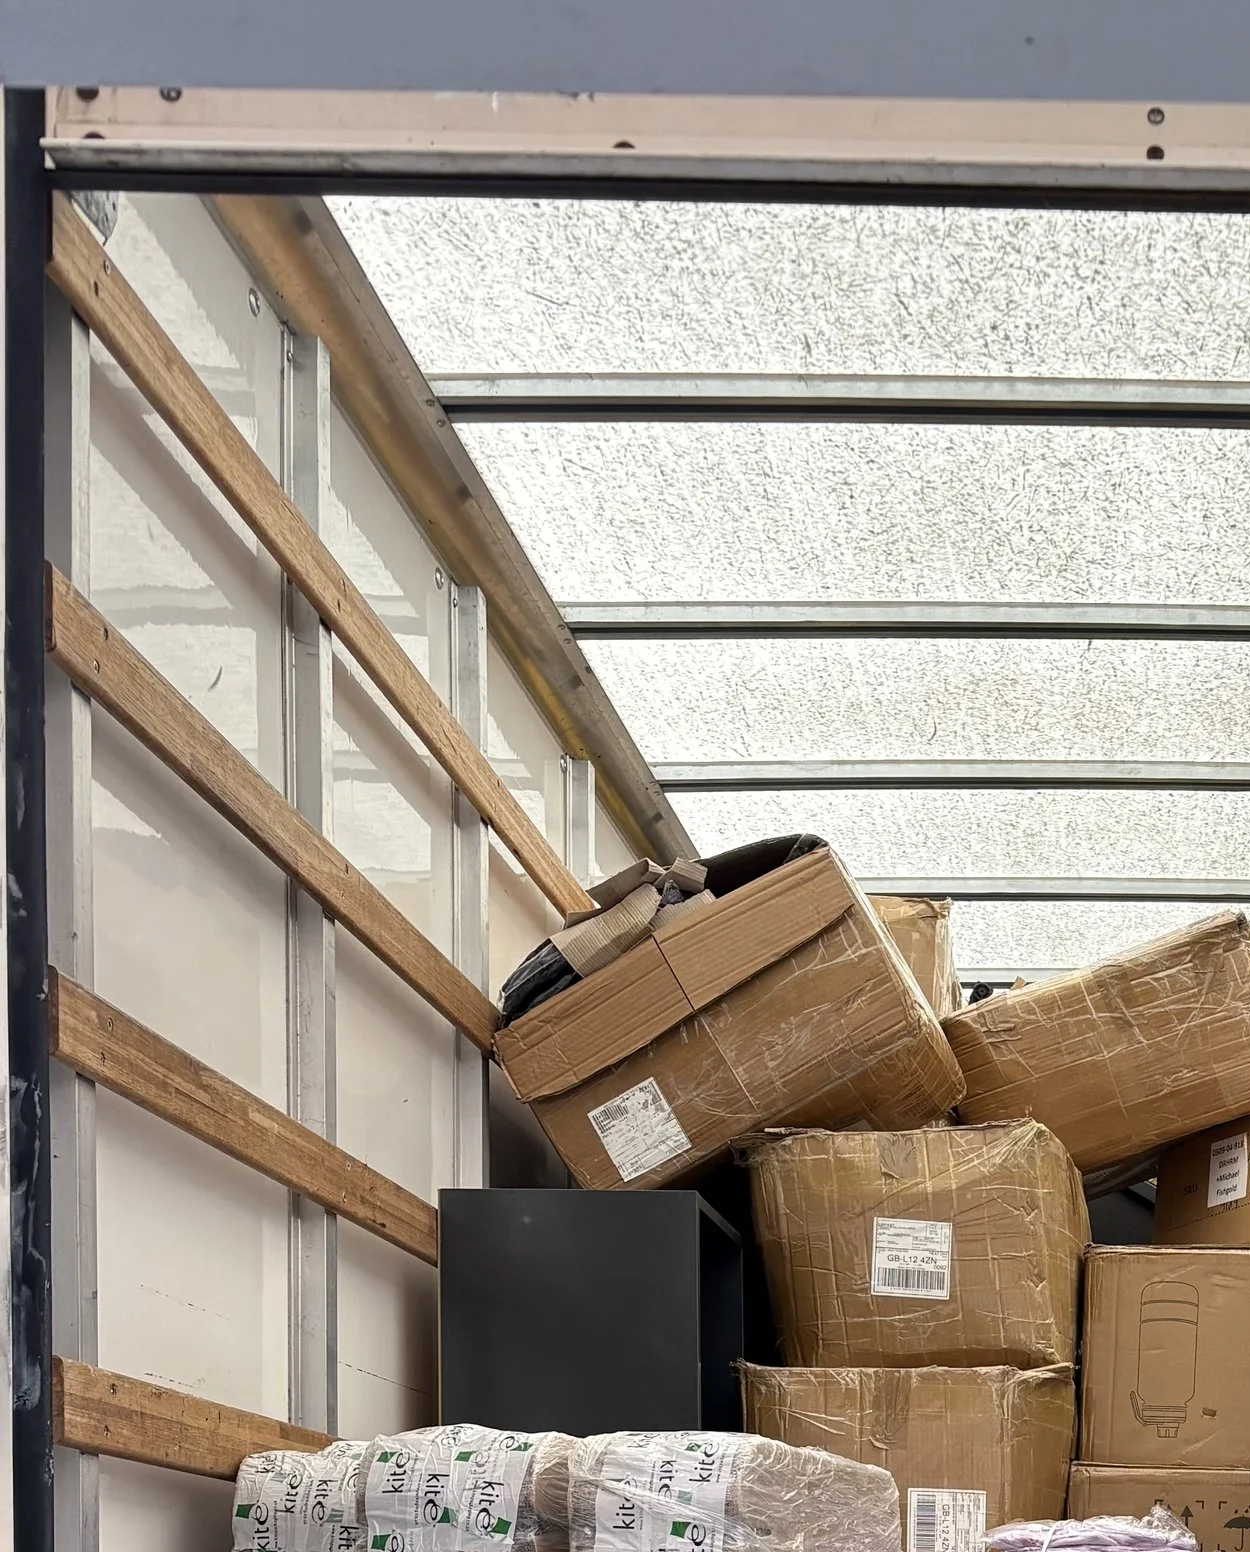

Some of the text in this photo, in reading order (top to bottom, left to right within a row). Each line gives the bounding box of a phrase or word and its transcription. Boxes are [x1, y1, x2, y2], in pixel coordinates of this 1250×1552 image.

[382, 1450, 410, 1493] kite
[689, 1442, 719, 1483] kite
[281, 1473, 303, 1514] kite
[312, 1479, 338, 1524] kite
[423, 1473, 450, 1526] kite
[475, 1481, 504, 1534] kite
[252, 1501, 269, 1551] kite
